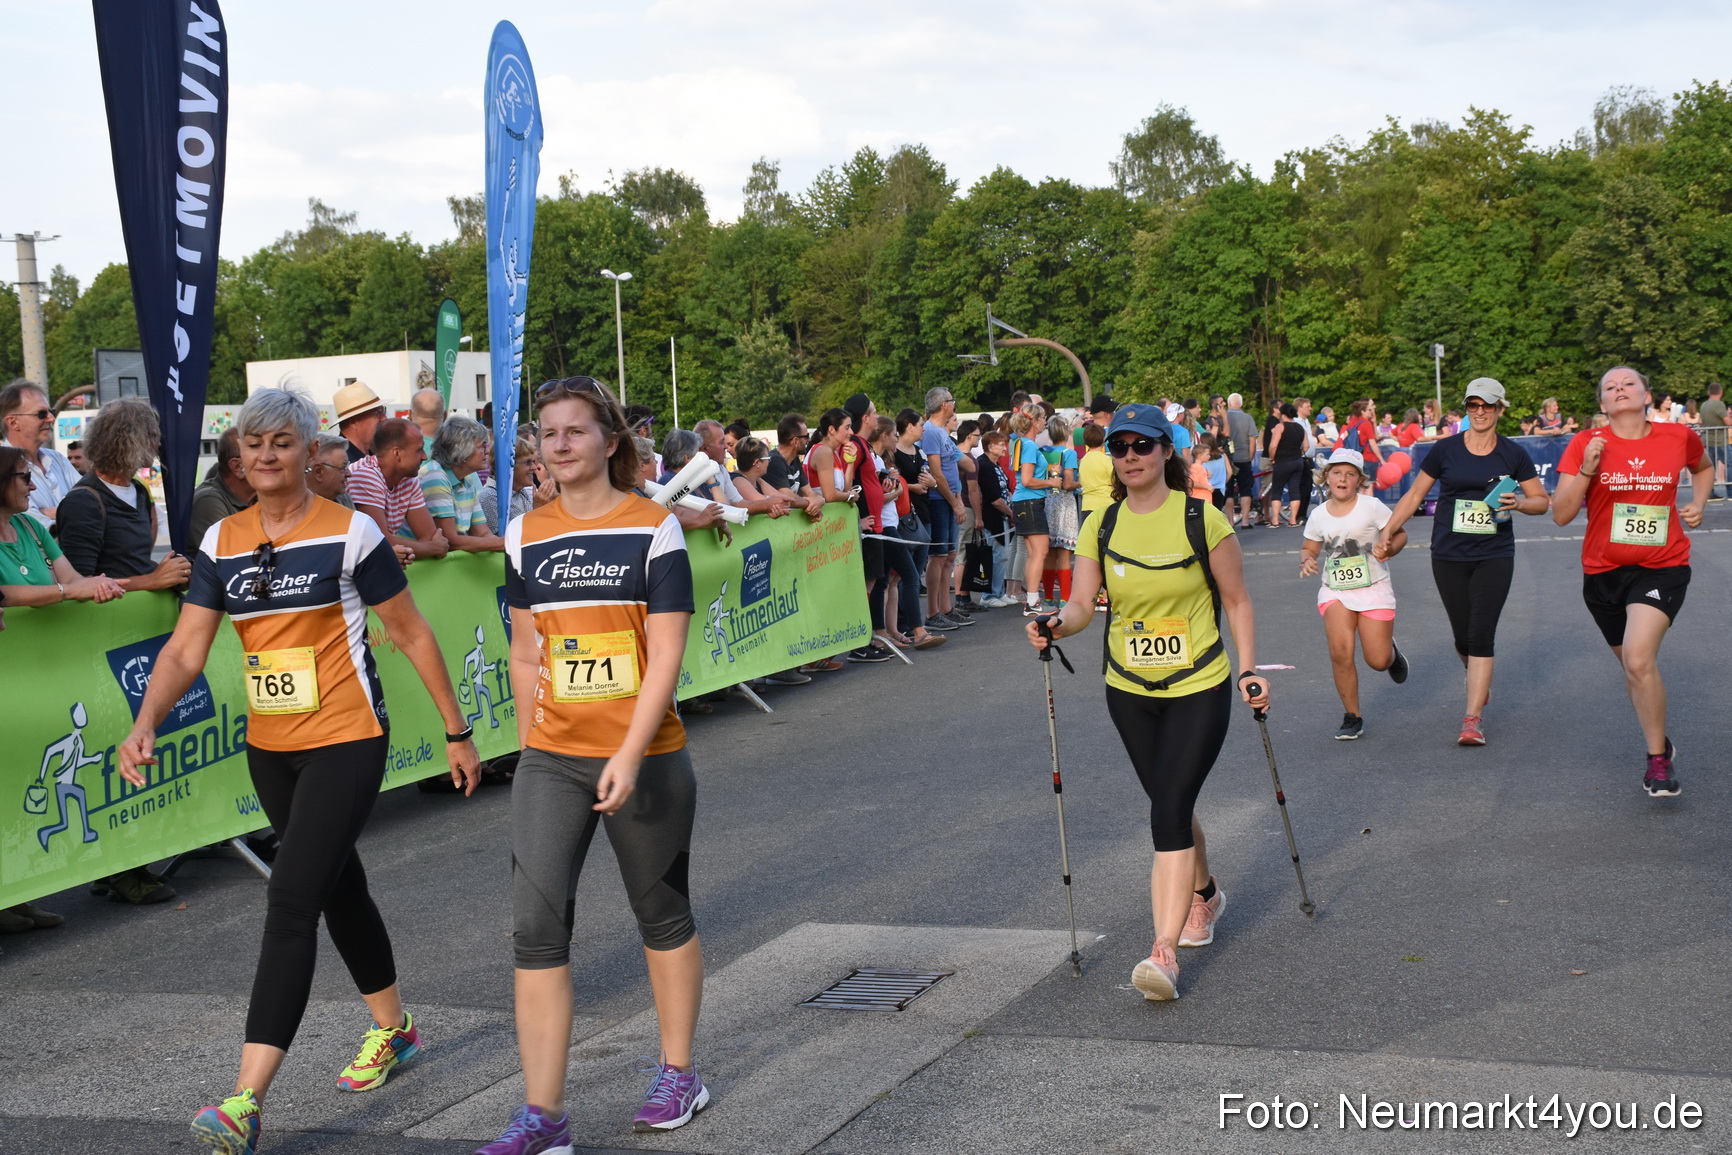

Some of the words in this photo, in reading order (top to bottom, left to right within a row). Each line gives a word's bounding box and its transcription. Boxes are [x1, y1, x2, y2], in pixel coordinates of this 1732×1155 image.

[1600, 472, 1629, 485] Echtes
[1629, 472, 1673, 485] Handwerk
[1460, 511, 1492, 525] 1432
[1624, 518, 1658, 535] 585
[551, 560, 631, 580] Fischer
[747, 560, 769, 576] Fischer
[1332, 567, 1363, 581] 1393
[239, 573, 319, 594] Ficher
[559, 579, 622, 589] AUTOMOBILE
[729, 578, 799, 642] firmenlauf
[736, 630, 768, 656] neumarkt
[1129, 635, 1181, 657] 1200
[565, 657, 613, 684] 771
[251, 672, 296, 697] 768
[594, 682, 619, 690] Dorner
[274, 696, 298, 704] Schmid
[109, 778, 192, 830] neumarkt
